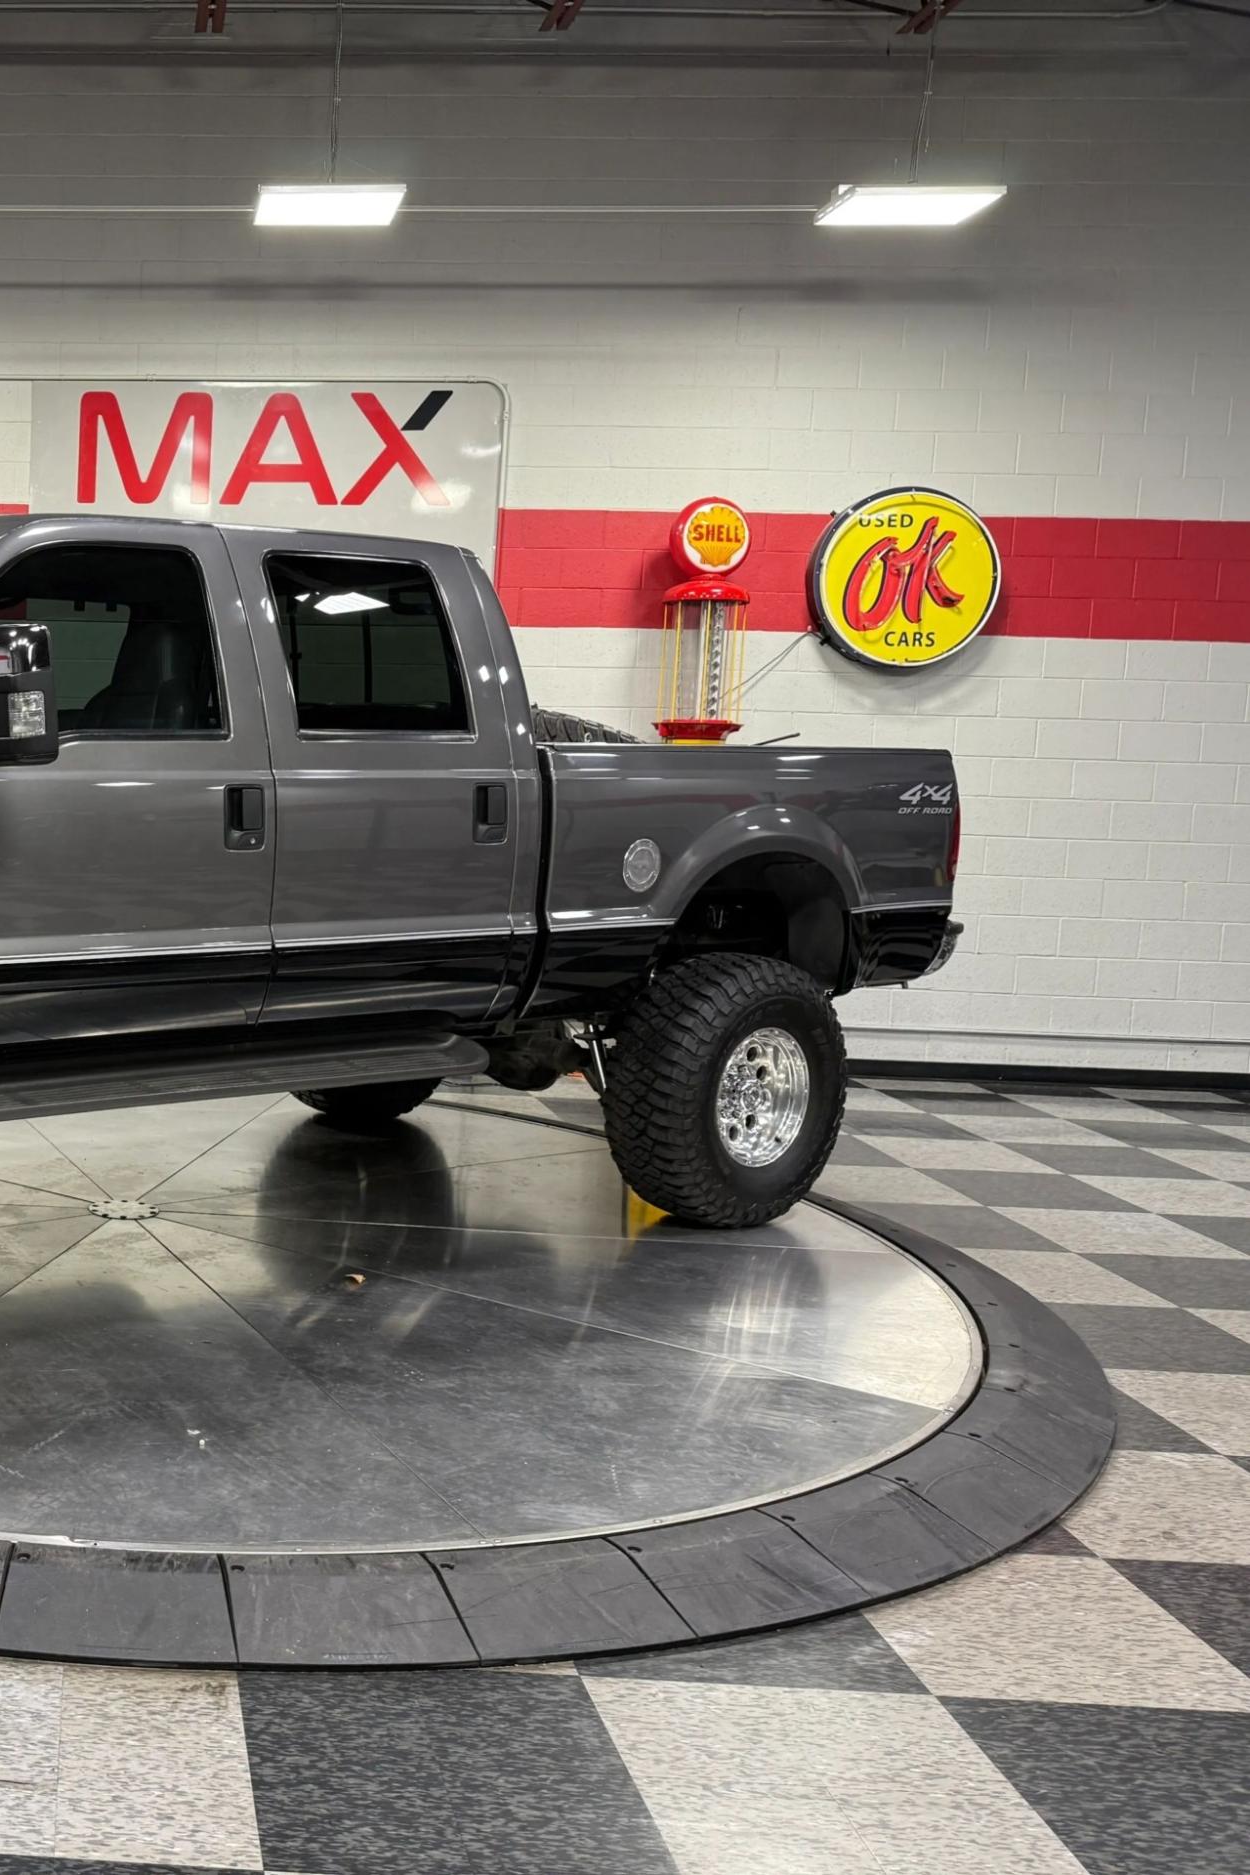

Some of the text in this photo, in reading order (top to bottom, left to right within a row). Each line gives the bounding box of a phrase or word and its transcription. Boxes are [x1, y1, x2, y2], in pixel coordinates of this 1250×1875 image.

[76, 390, 454, 506] MAX
[858, 513, 914, 528] USED
[692, 524, 742, 543] SHELL
[842, 515, 965, 631] OK
[884, 631, 936, 648] CARS
